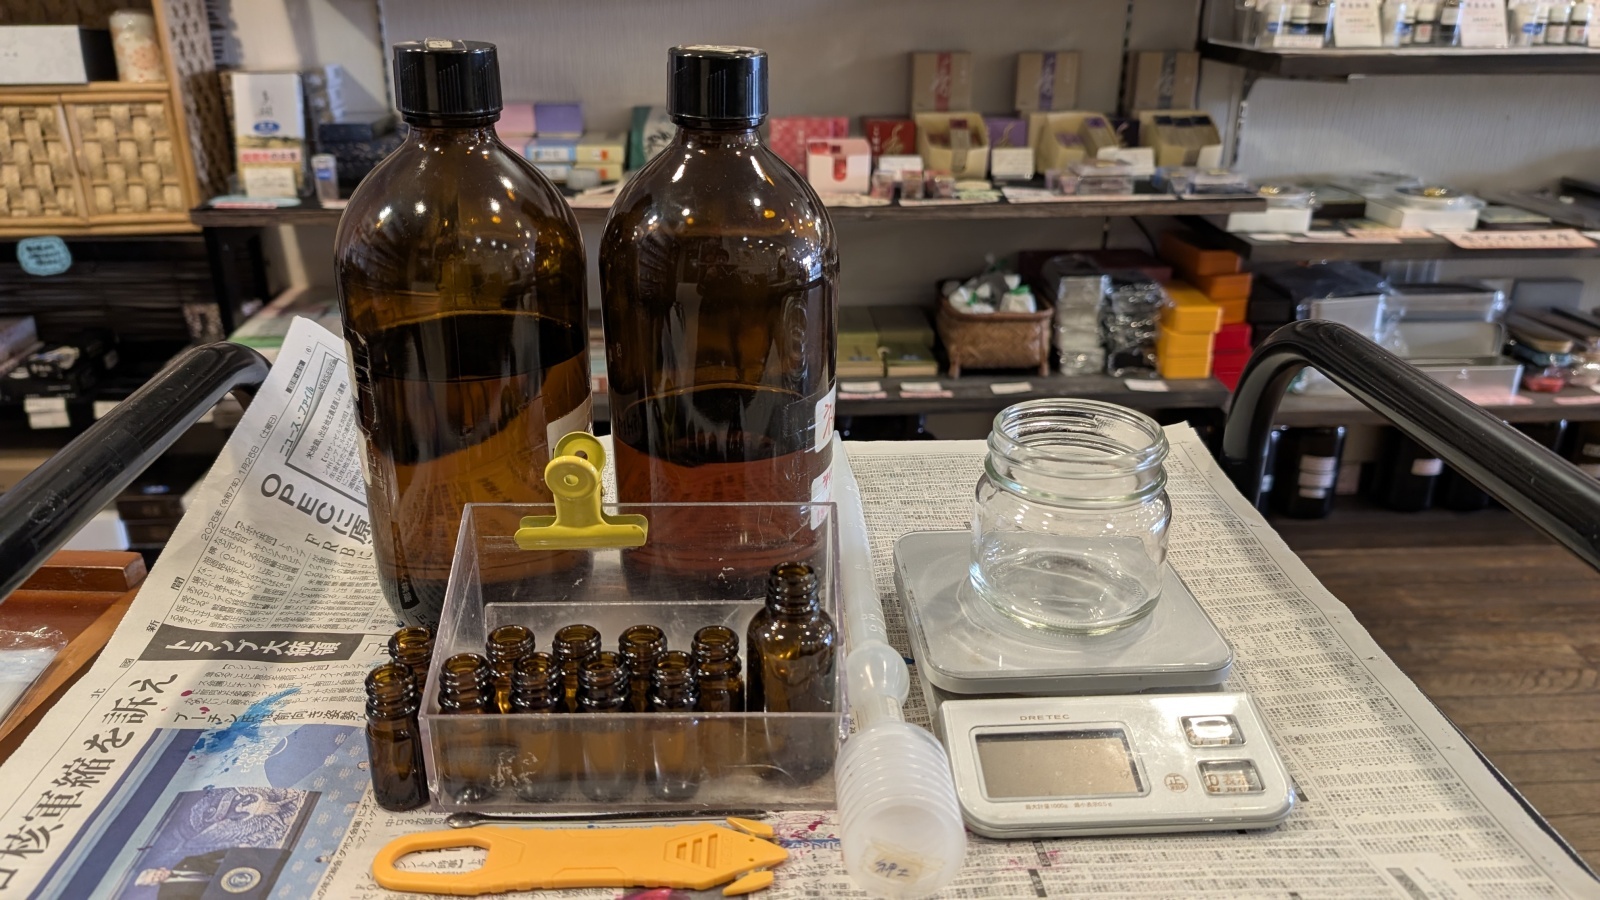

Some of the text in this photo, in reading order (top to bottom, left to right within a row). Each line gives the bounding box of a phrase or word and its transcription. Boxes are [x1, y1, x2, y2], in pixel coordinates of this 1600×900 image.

[259, 414, 278, 439] （土曜日）
[279, 385, 315, 457] ニュース・ファイル
[304, 533, 373, 562] FRBに
[164, 638, 342, 657] トランプ大統領
